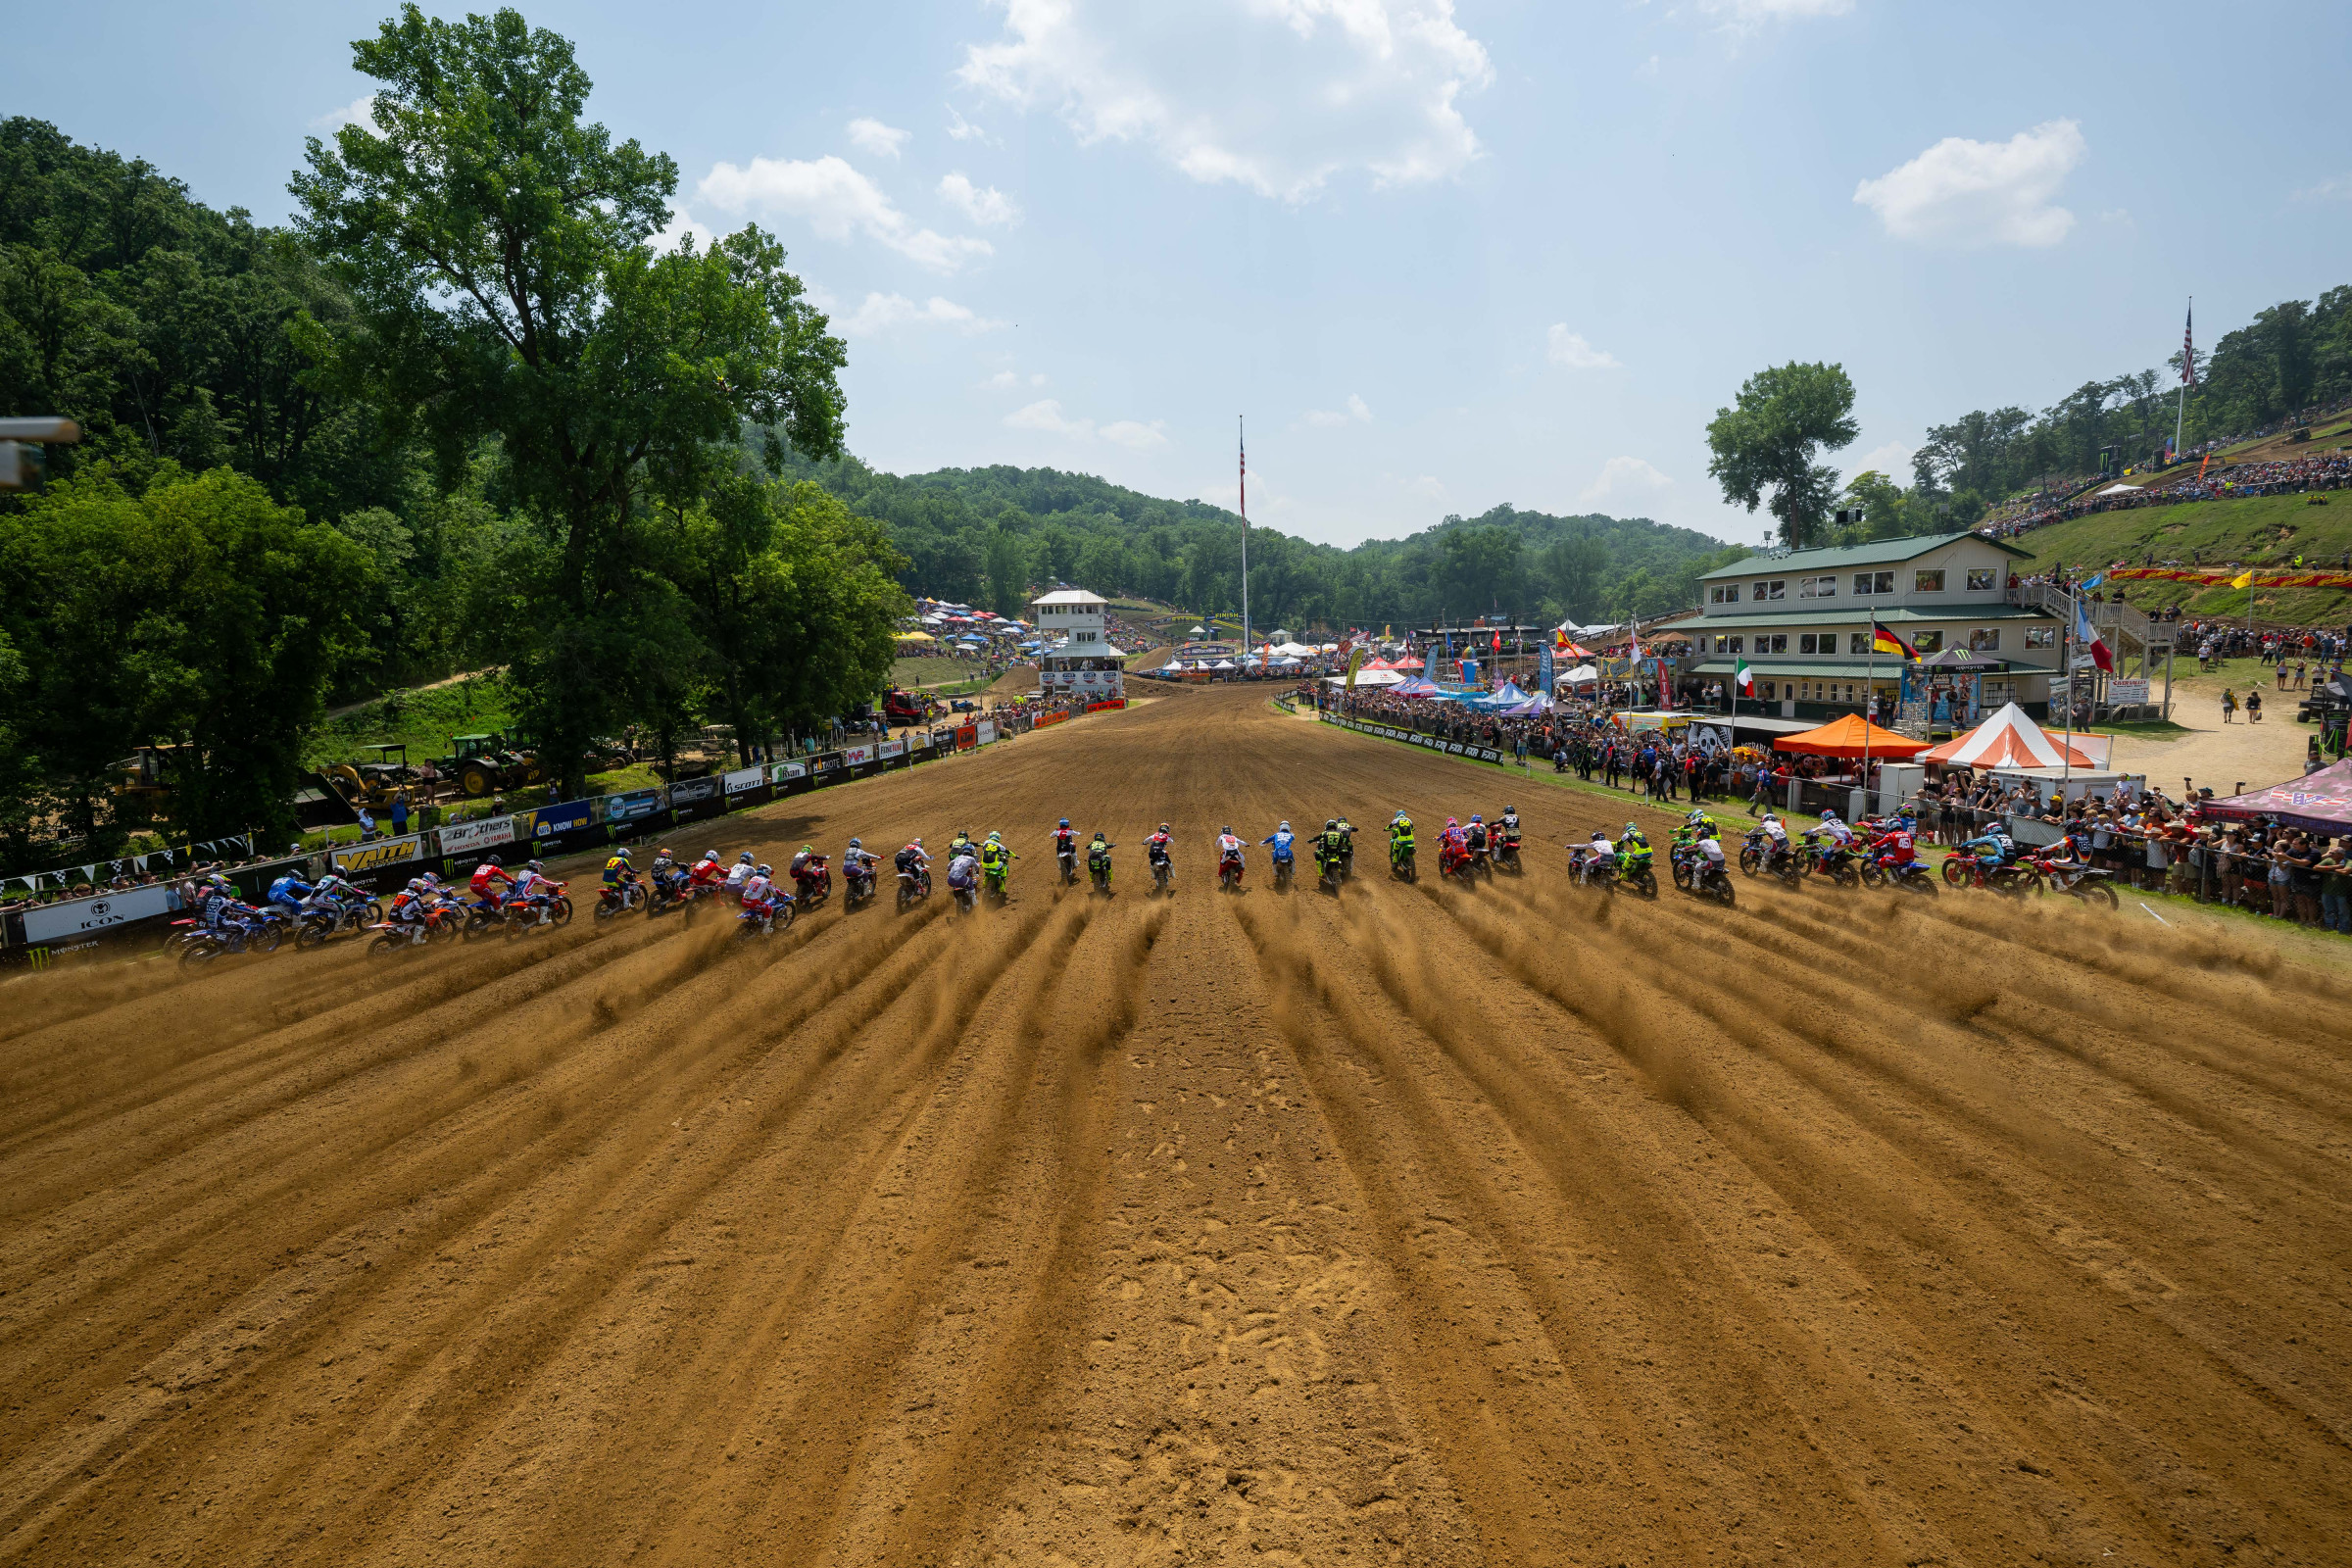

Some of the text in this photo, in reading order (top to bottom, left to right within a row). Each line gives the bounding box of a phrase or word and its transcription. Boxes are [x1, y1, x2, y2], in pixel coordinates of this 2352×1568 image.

[1409, 734, 1423, 744] FXR
[1448, 743, 1463, 753] FXR
[1464, 747, 1479, 757] FXR
[1481, 750, 1497, 761] FXR
[782, 768, 801, 778] Ryan
[734, 779, 761, 791] SCOTT
[553, 816, 588, 832] KNOW HOW
[454, 841, 480, 852] HONDA
[490, 832, 512, 843] YAMAHA
[1898, 837, 1912, 850] 451
[336, 841, 417, 871] VAITH
[605, 859, 622, 869] 37
[80, 914, 125, 930] ICON
[51, 940, 99, 956] MONSTER
